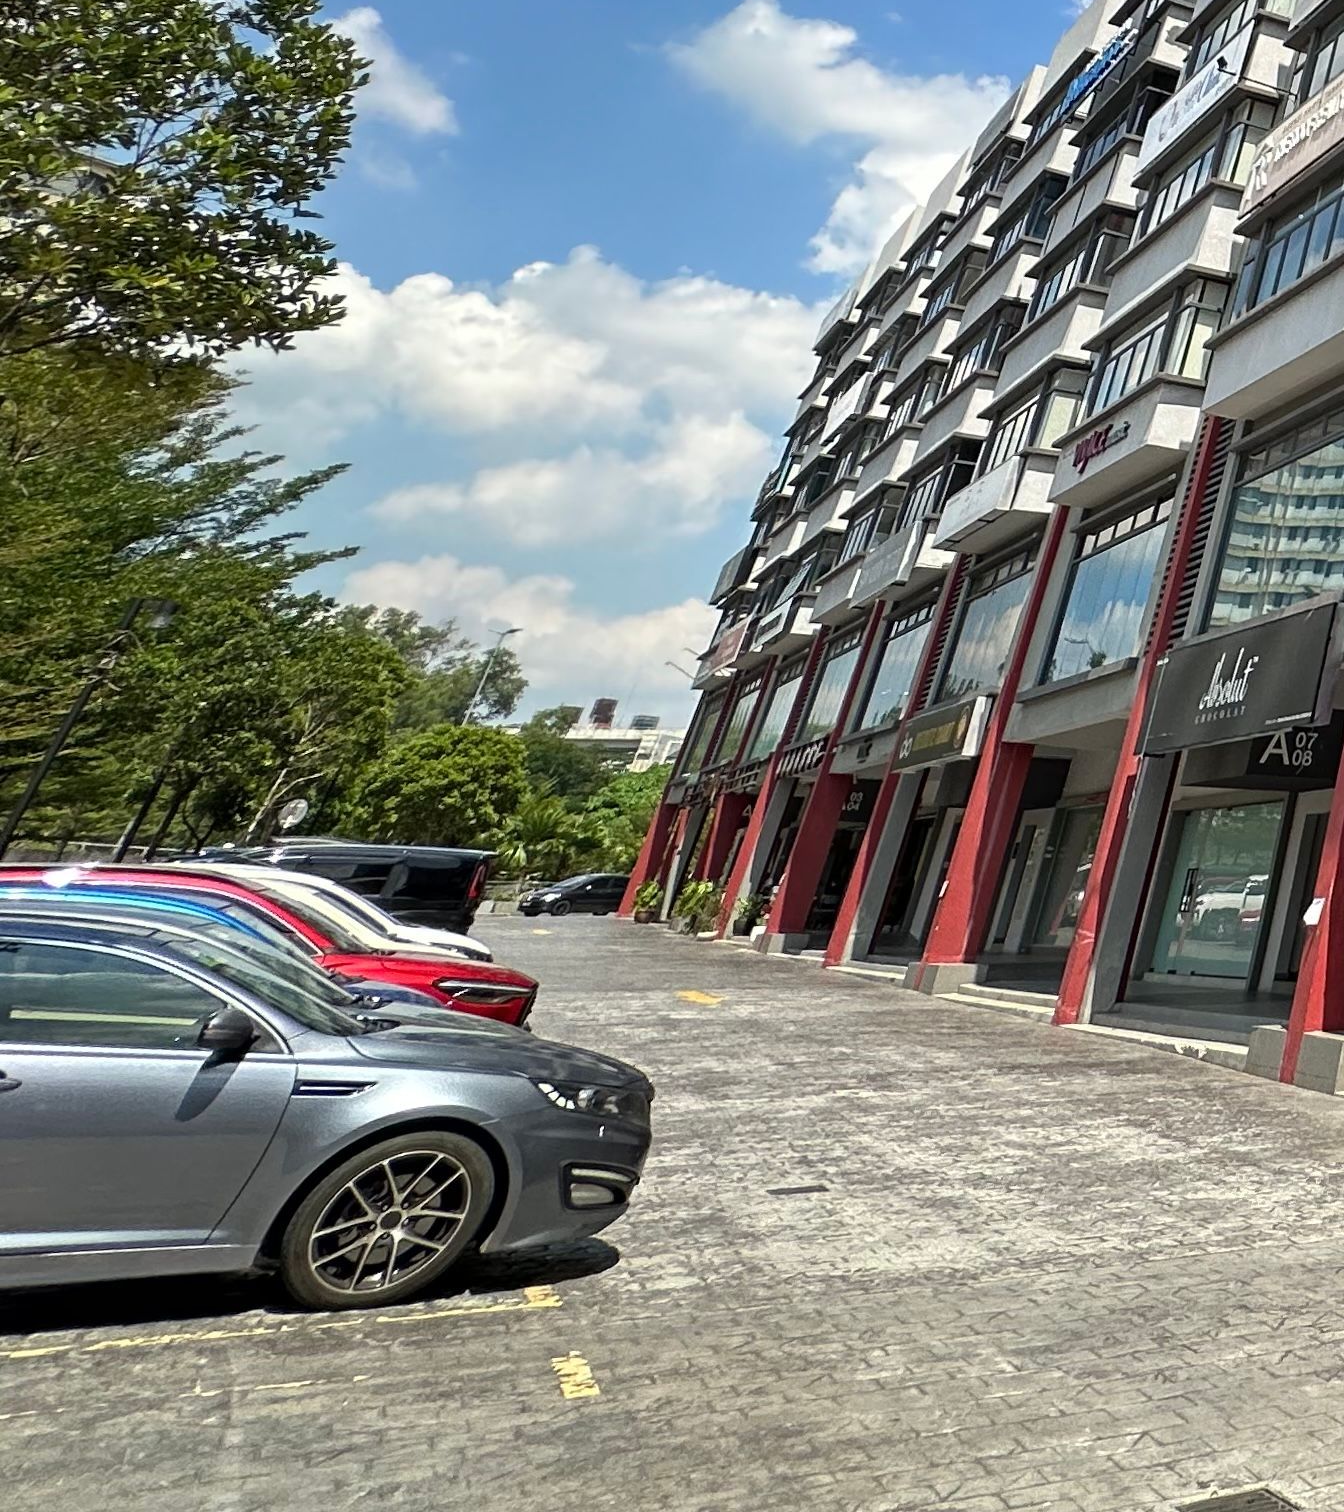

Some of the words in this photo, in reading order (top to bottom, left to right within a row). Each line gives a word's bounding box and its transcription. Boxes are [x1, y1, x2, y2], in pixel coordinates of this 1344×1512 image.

[1259, 730, 1290, 766] A
[1294, 732, 1319, 749] 07
[1291, 749, 1314, 767] 08
